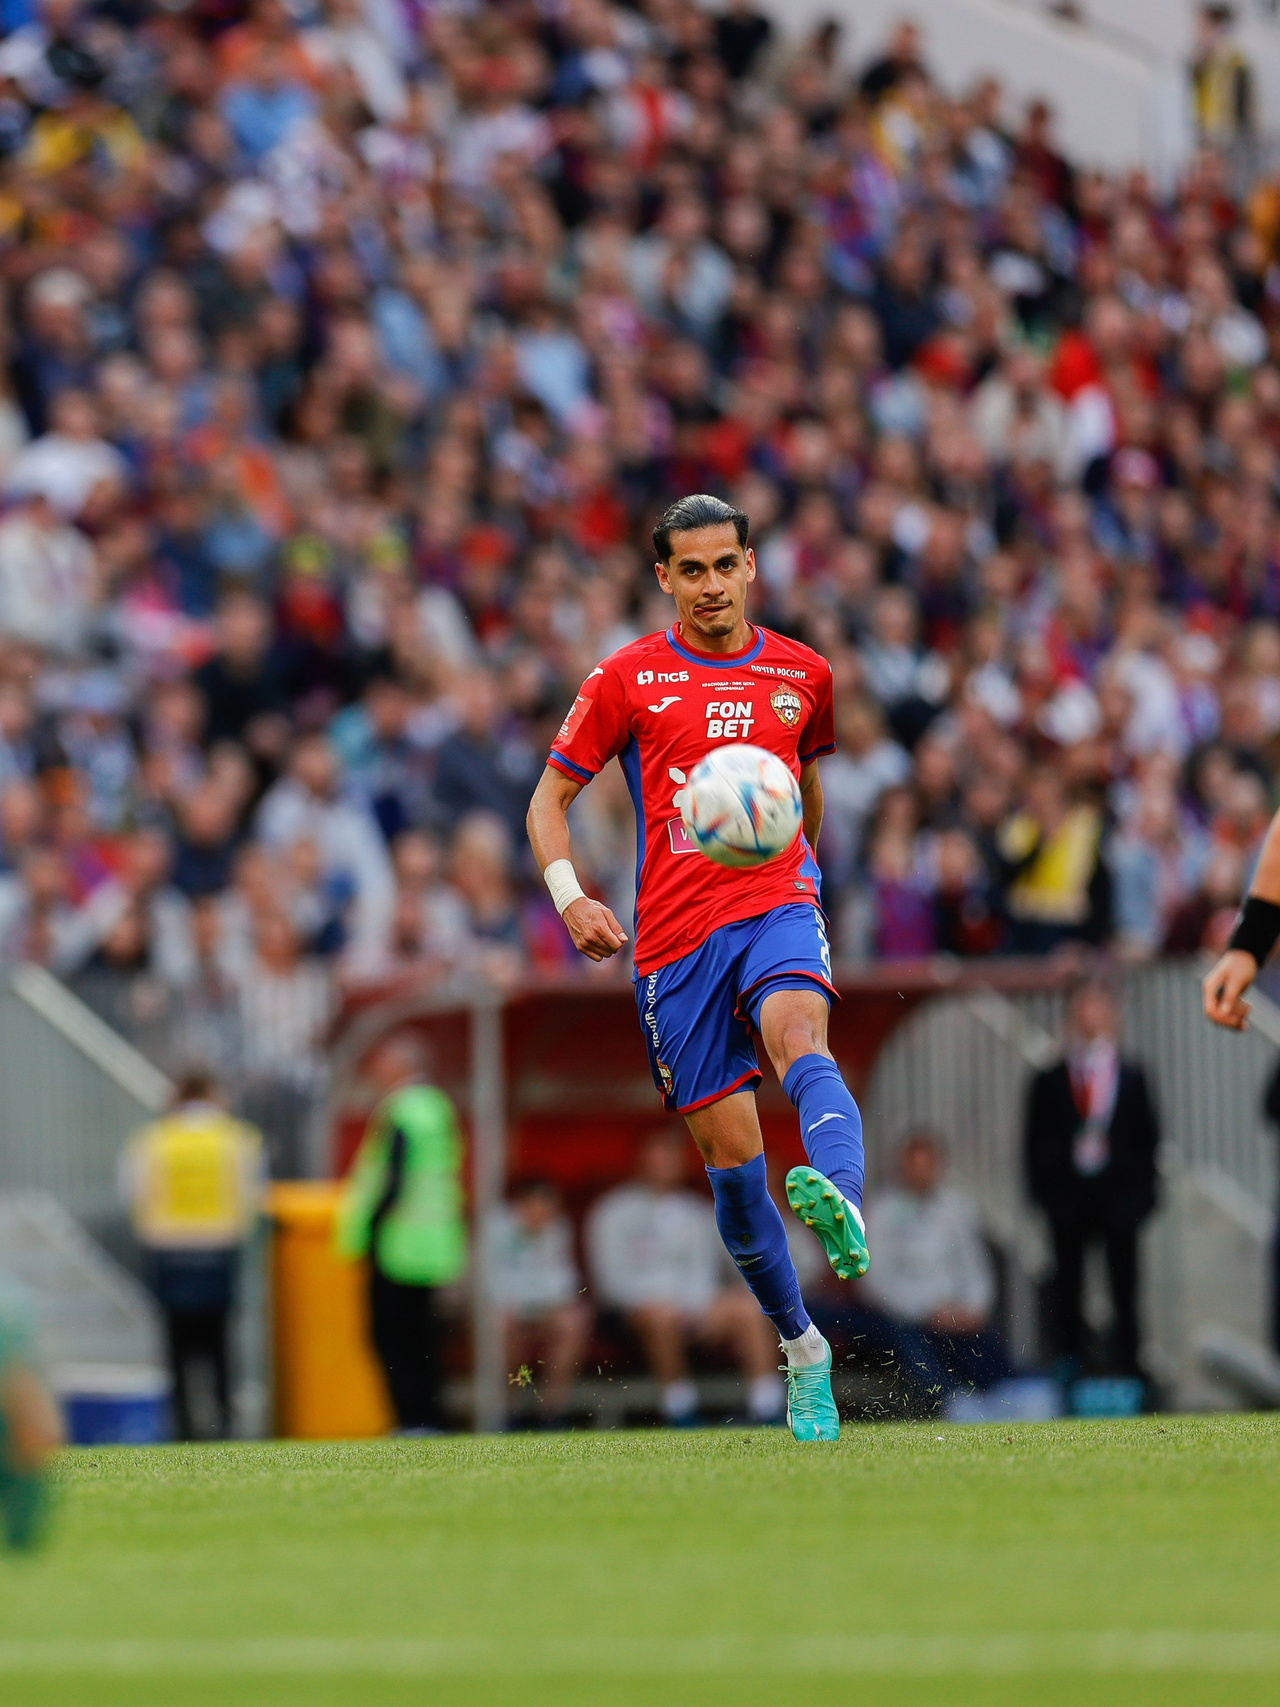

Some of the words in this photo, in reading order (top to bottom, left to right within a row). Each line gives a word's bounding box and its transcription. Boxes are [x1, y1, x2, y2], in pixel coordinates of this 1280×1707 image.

[657, 670, 690, 684] ПСБ
[750, 664, 776, 675] ПОЧТА
[776, 667, 807, 680] РОССИИ
[705, 701, 753, 719] FON
[773, 694, 801, 711] ЦСКА
[706, 719, 755, 738] BET
